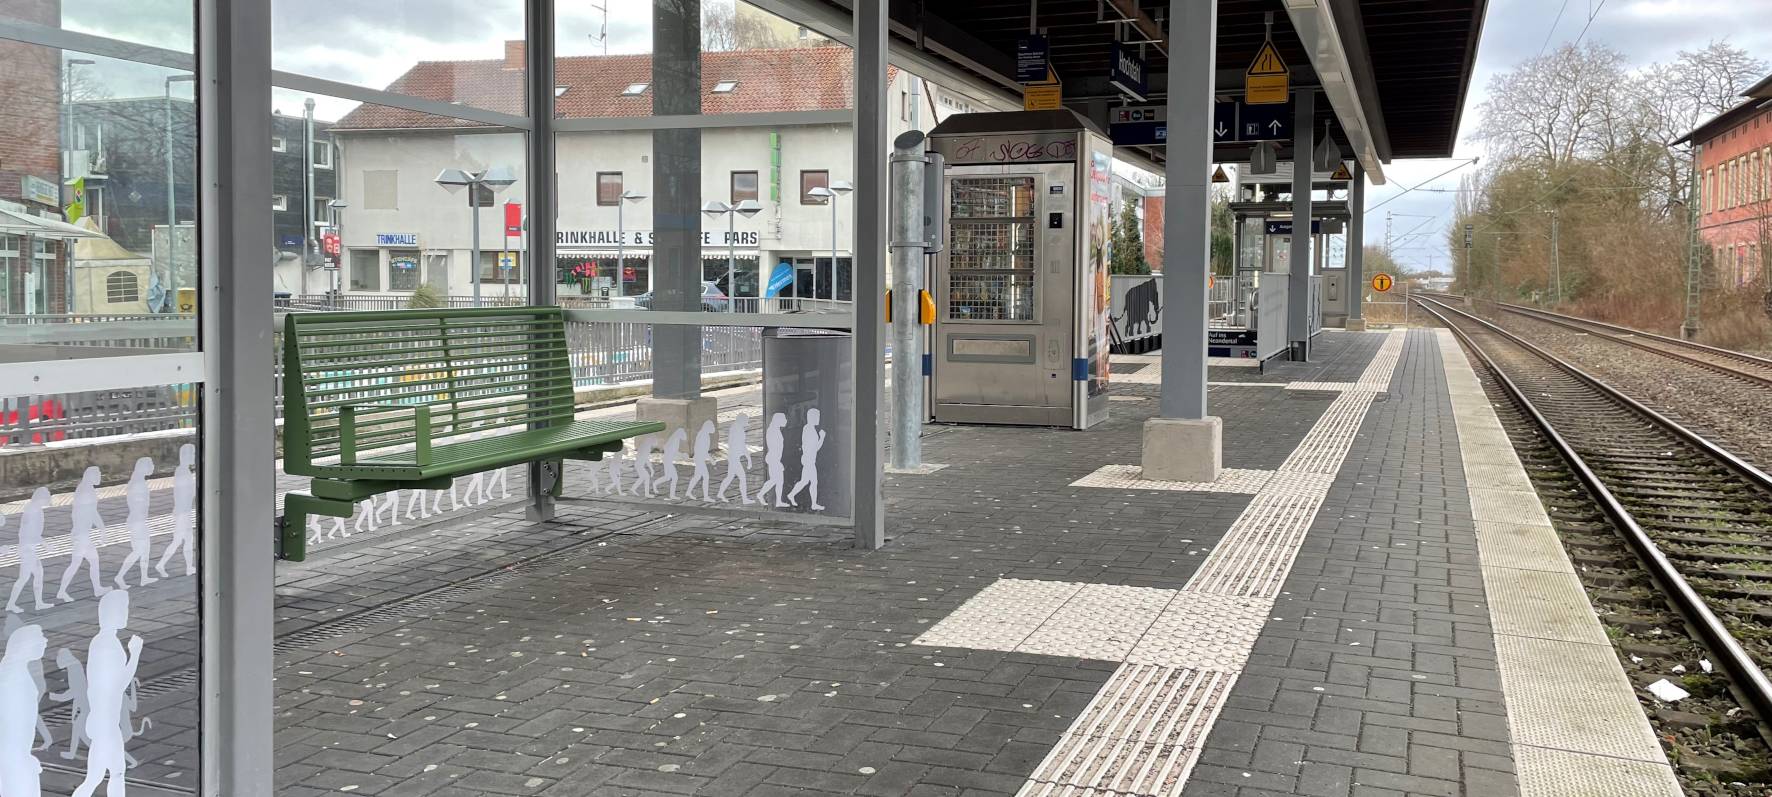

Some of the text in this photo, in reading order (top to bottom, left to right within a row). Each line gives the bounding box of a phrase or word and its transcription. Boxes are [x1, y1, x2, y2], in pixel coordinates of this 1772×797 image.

[1118, 48, 1141, 84] Hochdahl
[376, 234, 417, 245] TRINKHALLE
[556, 231, 626, 245] RINKHALLE
[634, 231, 643, 245] &
[724, 231, 757, 245] PARS
[1208, 337, 1238, 345] Neandertal
